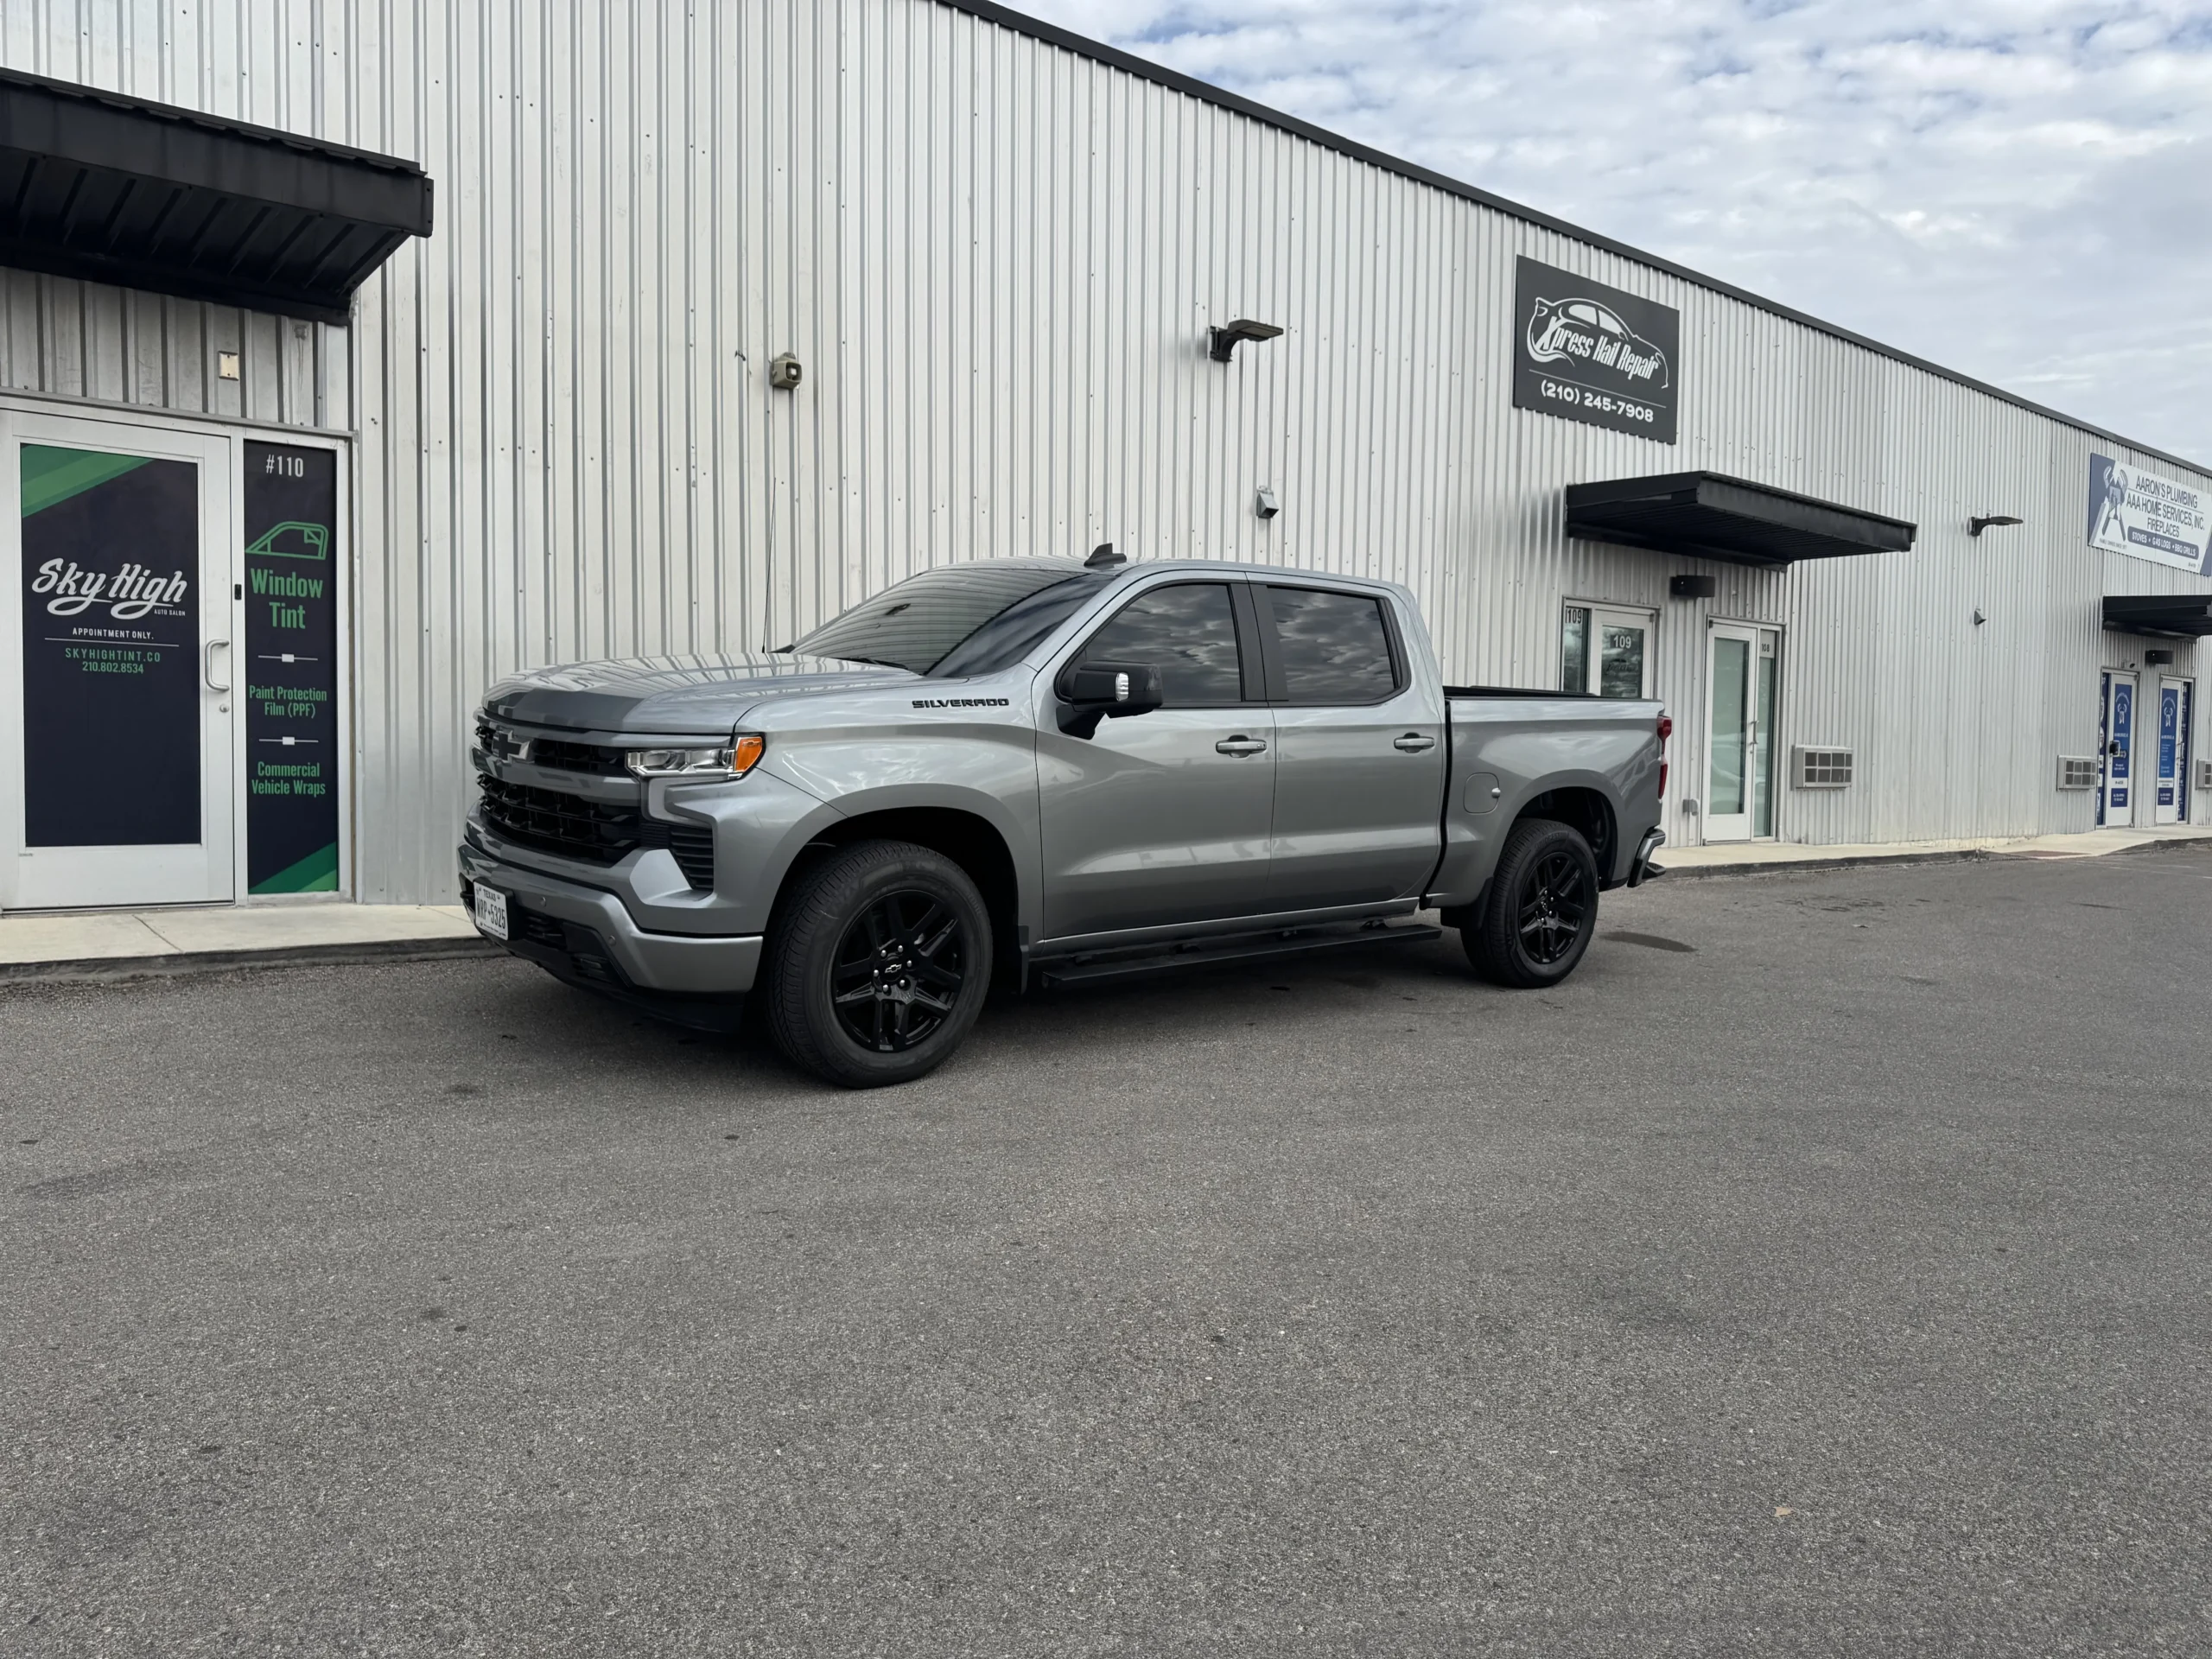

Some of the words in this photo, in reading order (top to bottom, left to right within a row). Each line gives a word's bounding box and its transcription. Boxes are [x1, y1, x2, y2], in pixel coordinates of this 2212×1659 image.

[1532, 315, 1594, 358] Xpress
[1592, 335, 1621, 366] Hail
[1617, 344, 1659, 380] Repair
[1541, 379, 1580, 404] (210)
[1584, 392, 1654, 423] 245-7908
[266, 454, 303, 477] #110
[2136, 475, 2165, 498] AARON'S
[2166, 485, 2197, 508] PLUMBING
[2126, 493, 2140, 512] AAA
[2141, 497, 2162, 517] HOME
[2163, 504, 2194, 529] SERVICES,
[2194, 515, 2205, 531] INC.
[2147, 518, 2180, 537] FIREPLACES
[2132, 531, 2147, 543] STOVES
[2161, 539, 2171, 550] LOGS
[2183, 545, 2196, 556] GRILLS
[31, 557, 113, 616] Sky
[108, 563, 188, 620] High
[250, 568, 323, 599] Window
[269, 601, 306, 629] Tint
[73, 627, 130, 639] APPOINTMENT
[131, 630, 154, 639] ONLY.
[1613, 634, 1631, 649] 109
[65, 648, 161, 662] SKYHIGHTINT.CO
[1761, 643, 1770, 652] 108
[82, 661, 144, 674] 210.802.8534
[249, 685, 275, 700] Paint
[277, 686, 327, 702] Protection
[264, 702, 284, 715] Film
[287, 702, 316, 719] (PPF)
[912, 698, 1009, 709] SILVERADO
[257, 761, 320, 777] Commercial
[251, 779, 290, 794] Vehicle
[294, 780, 326, 798] Wraps
[483, 888, 497, 902] TEXAS
